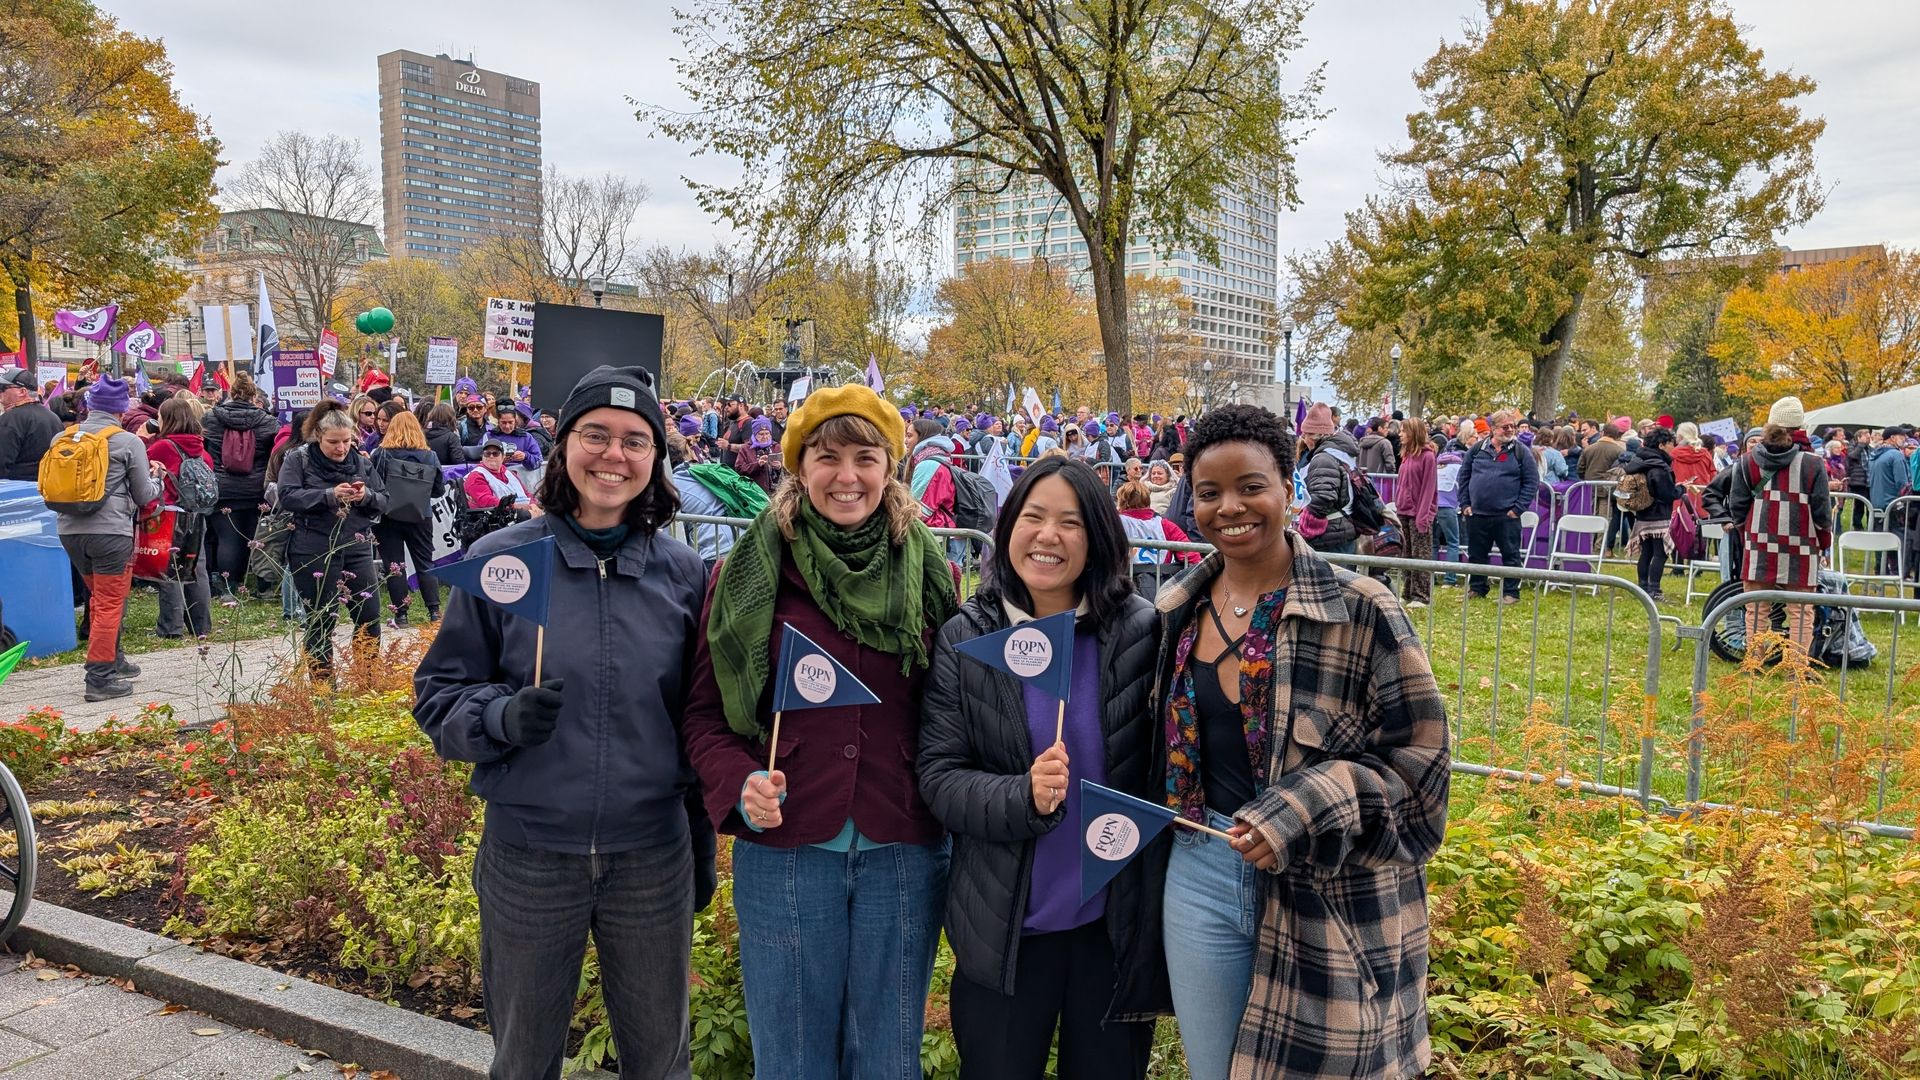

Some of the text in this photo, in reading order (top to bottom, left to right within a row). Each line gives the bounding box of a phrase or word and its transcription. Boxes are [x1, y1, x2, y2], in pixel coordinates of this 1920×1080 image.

[455, 81, 487, 97] DELTA
[490, 299, 503, 309] PAS
[507, 301, 515, 310] DE
[496, 326, 508, 335] 100
[291, 389, 319, 397] monde
[303, 398, 318, 406] paix
[487, 566, 524, 582] FQPN
[1011, 639, 1046, 655] FQPN
[801, 663, 832, 682] FQPN
[1095, 817, 1119, 852] FQPN
